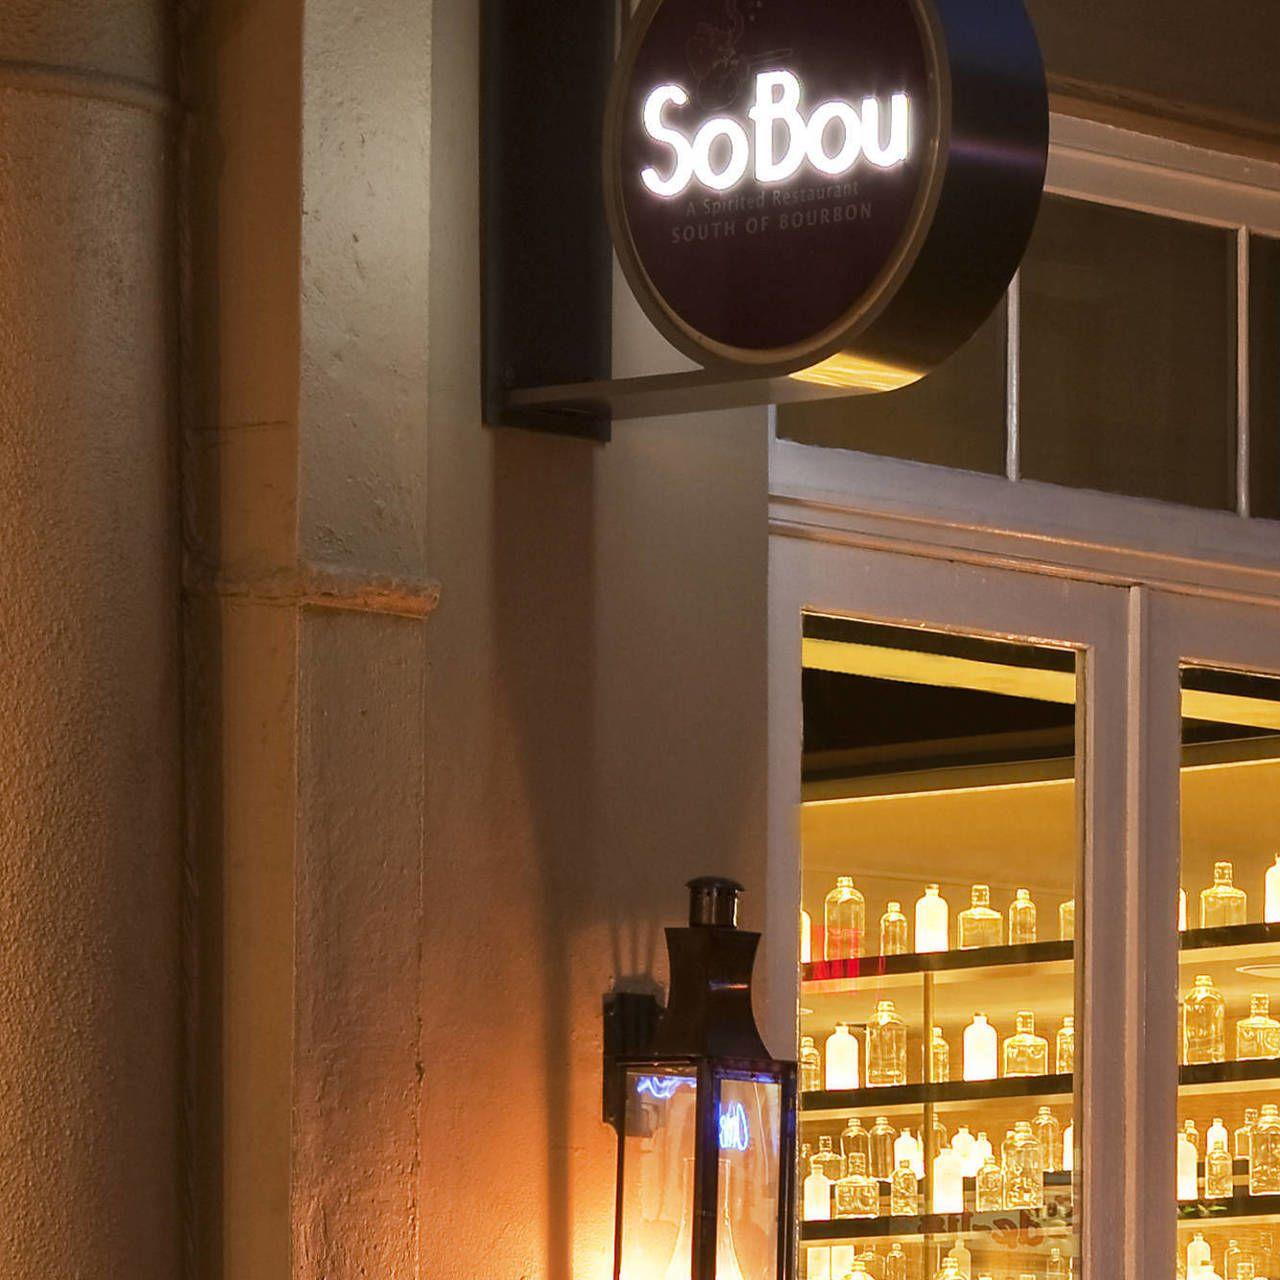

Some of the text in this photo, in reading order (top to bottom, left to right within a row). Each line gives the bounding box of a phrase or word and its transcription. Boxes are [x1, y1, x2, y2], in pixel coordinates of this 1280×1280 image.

[641, 69, 911, 197] SoBou
[686, 180, 861, 217] A Spirited Restaurant
[672, 202, 873, 244] SOUTH OF BOURBON
